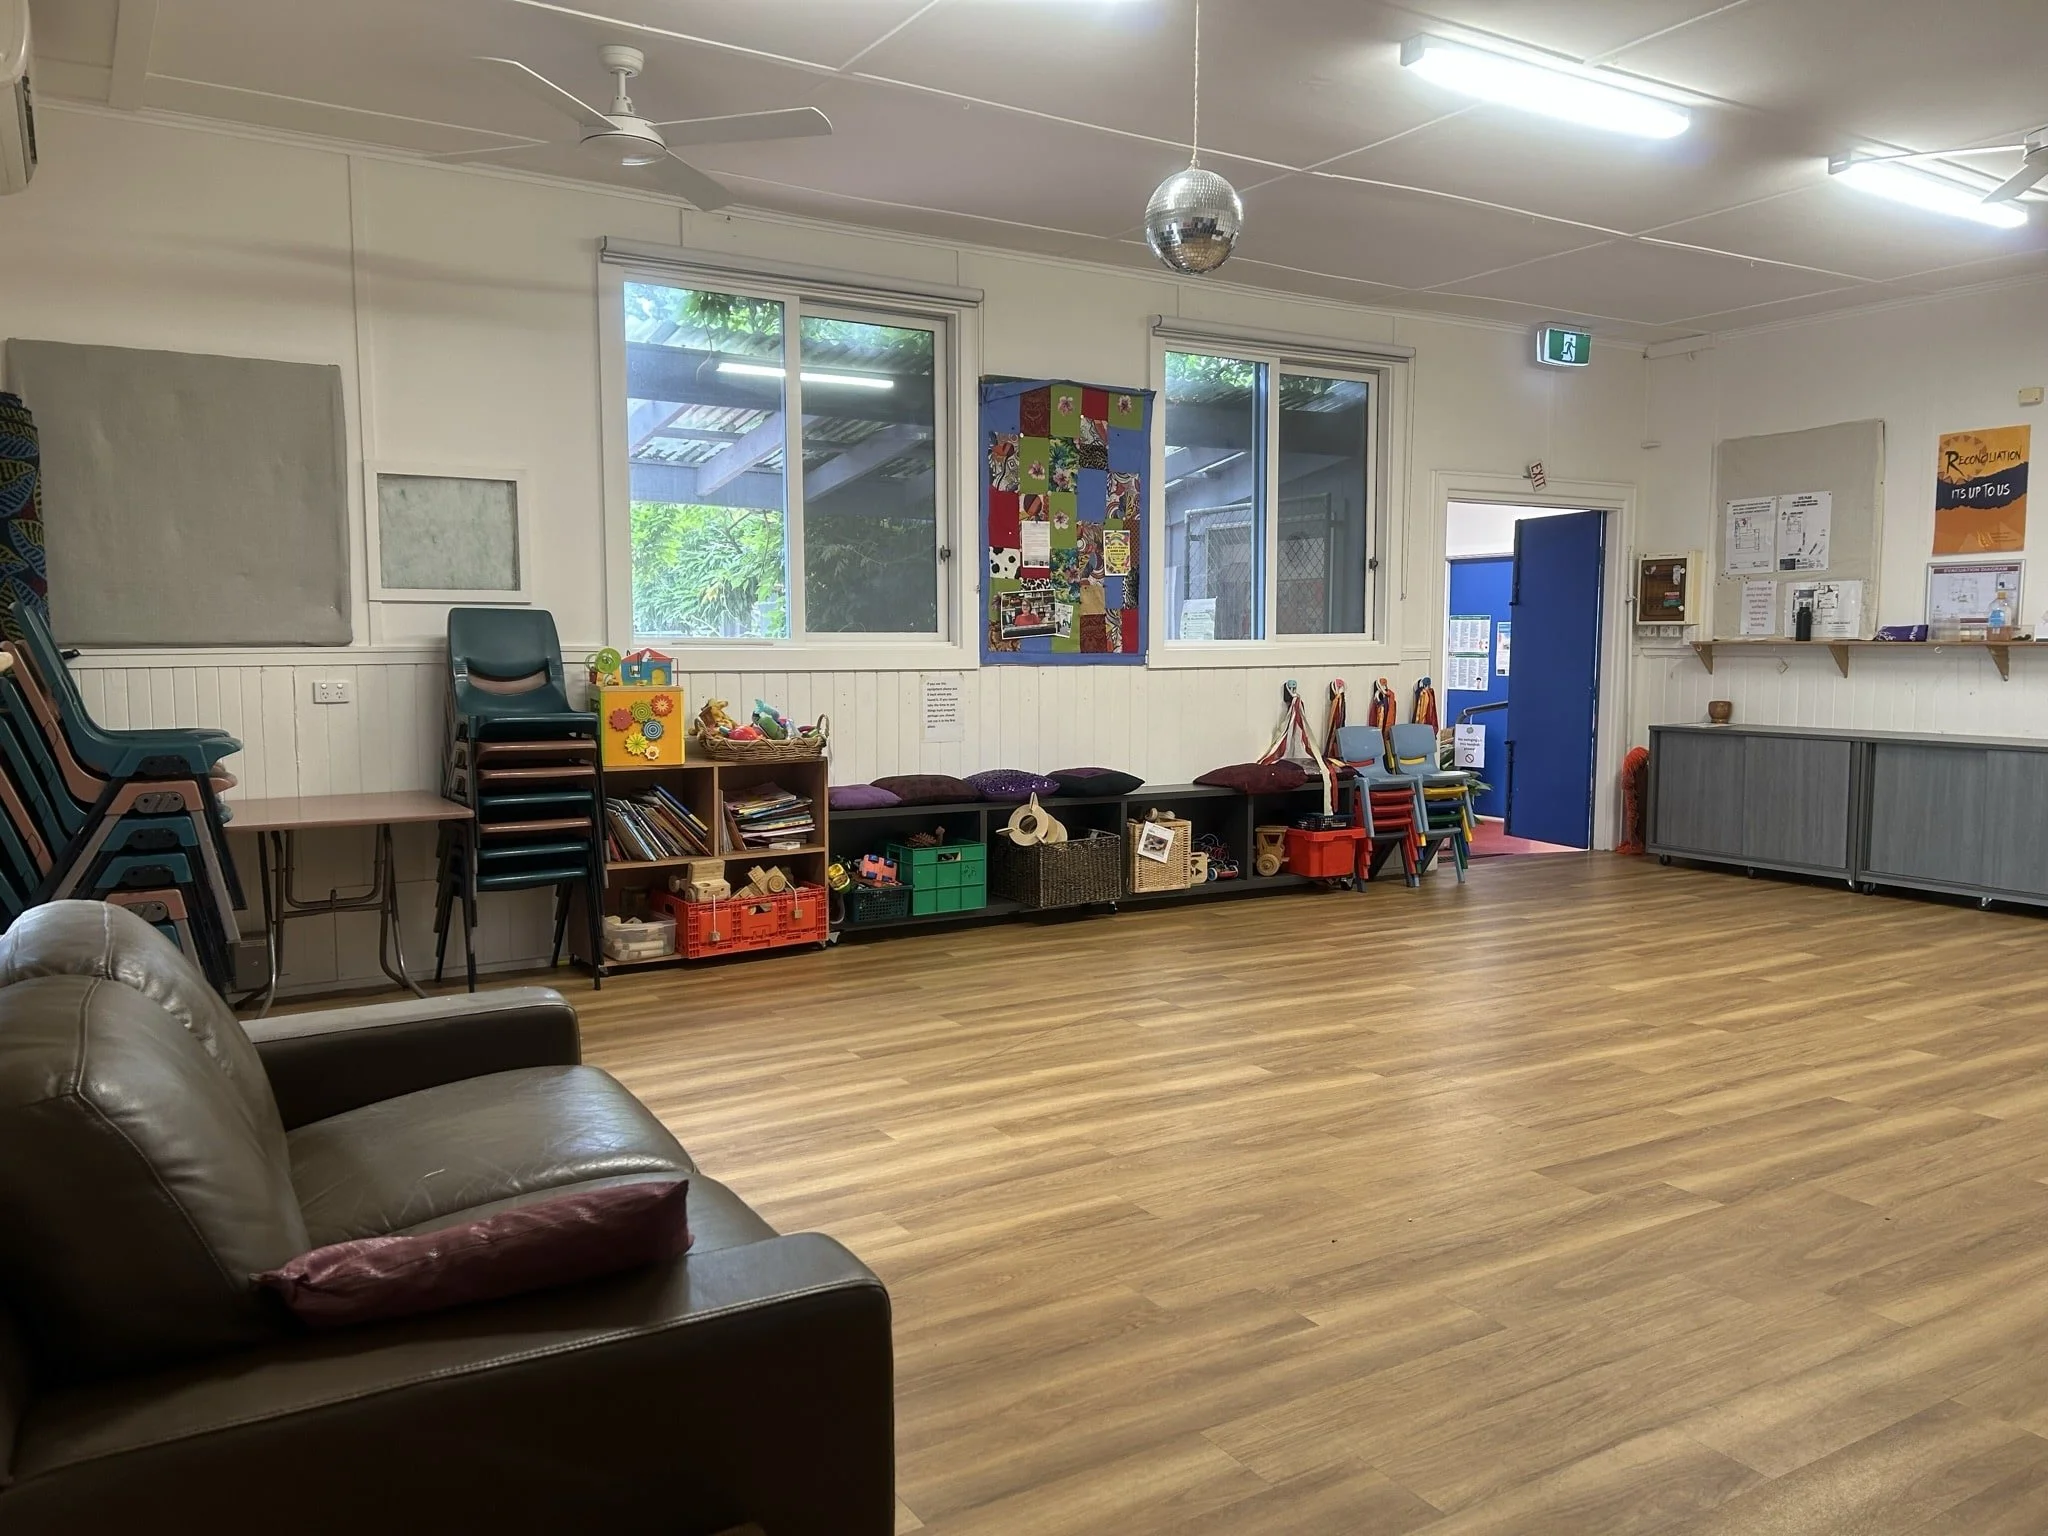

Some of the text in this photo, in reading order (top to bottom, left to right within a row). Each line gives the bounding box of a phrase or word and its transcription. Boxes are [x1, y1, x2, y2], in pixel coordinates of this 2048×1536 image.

[1531, 462, 1546, 488] EXIT
[1944, 448, 2022, 477] RECONCILIATION
[1968, 486, 1981, 499] UP
[1981, 482, 1996, 498] TO
[1996, 483, 2011, 497] US
